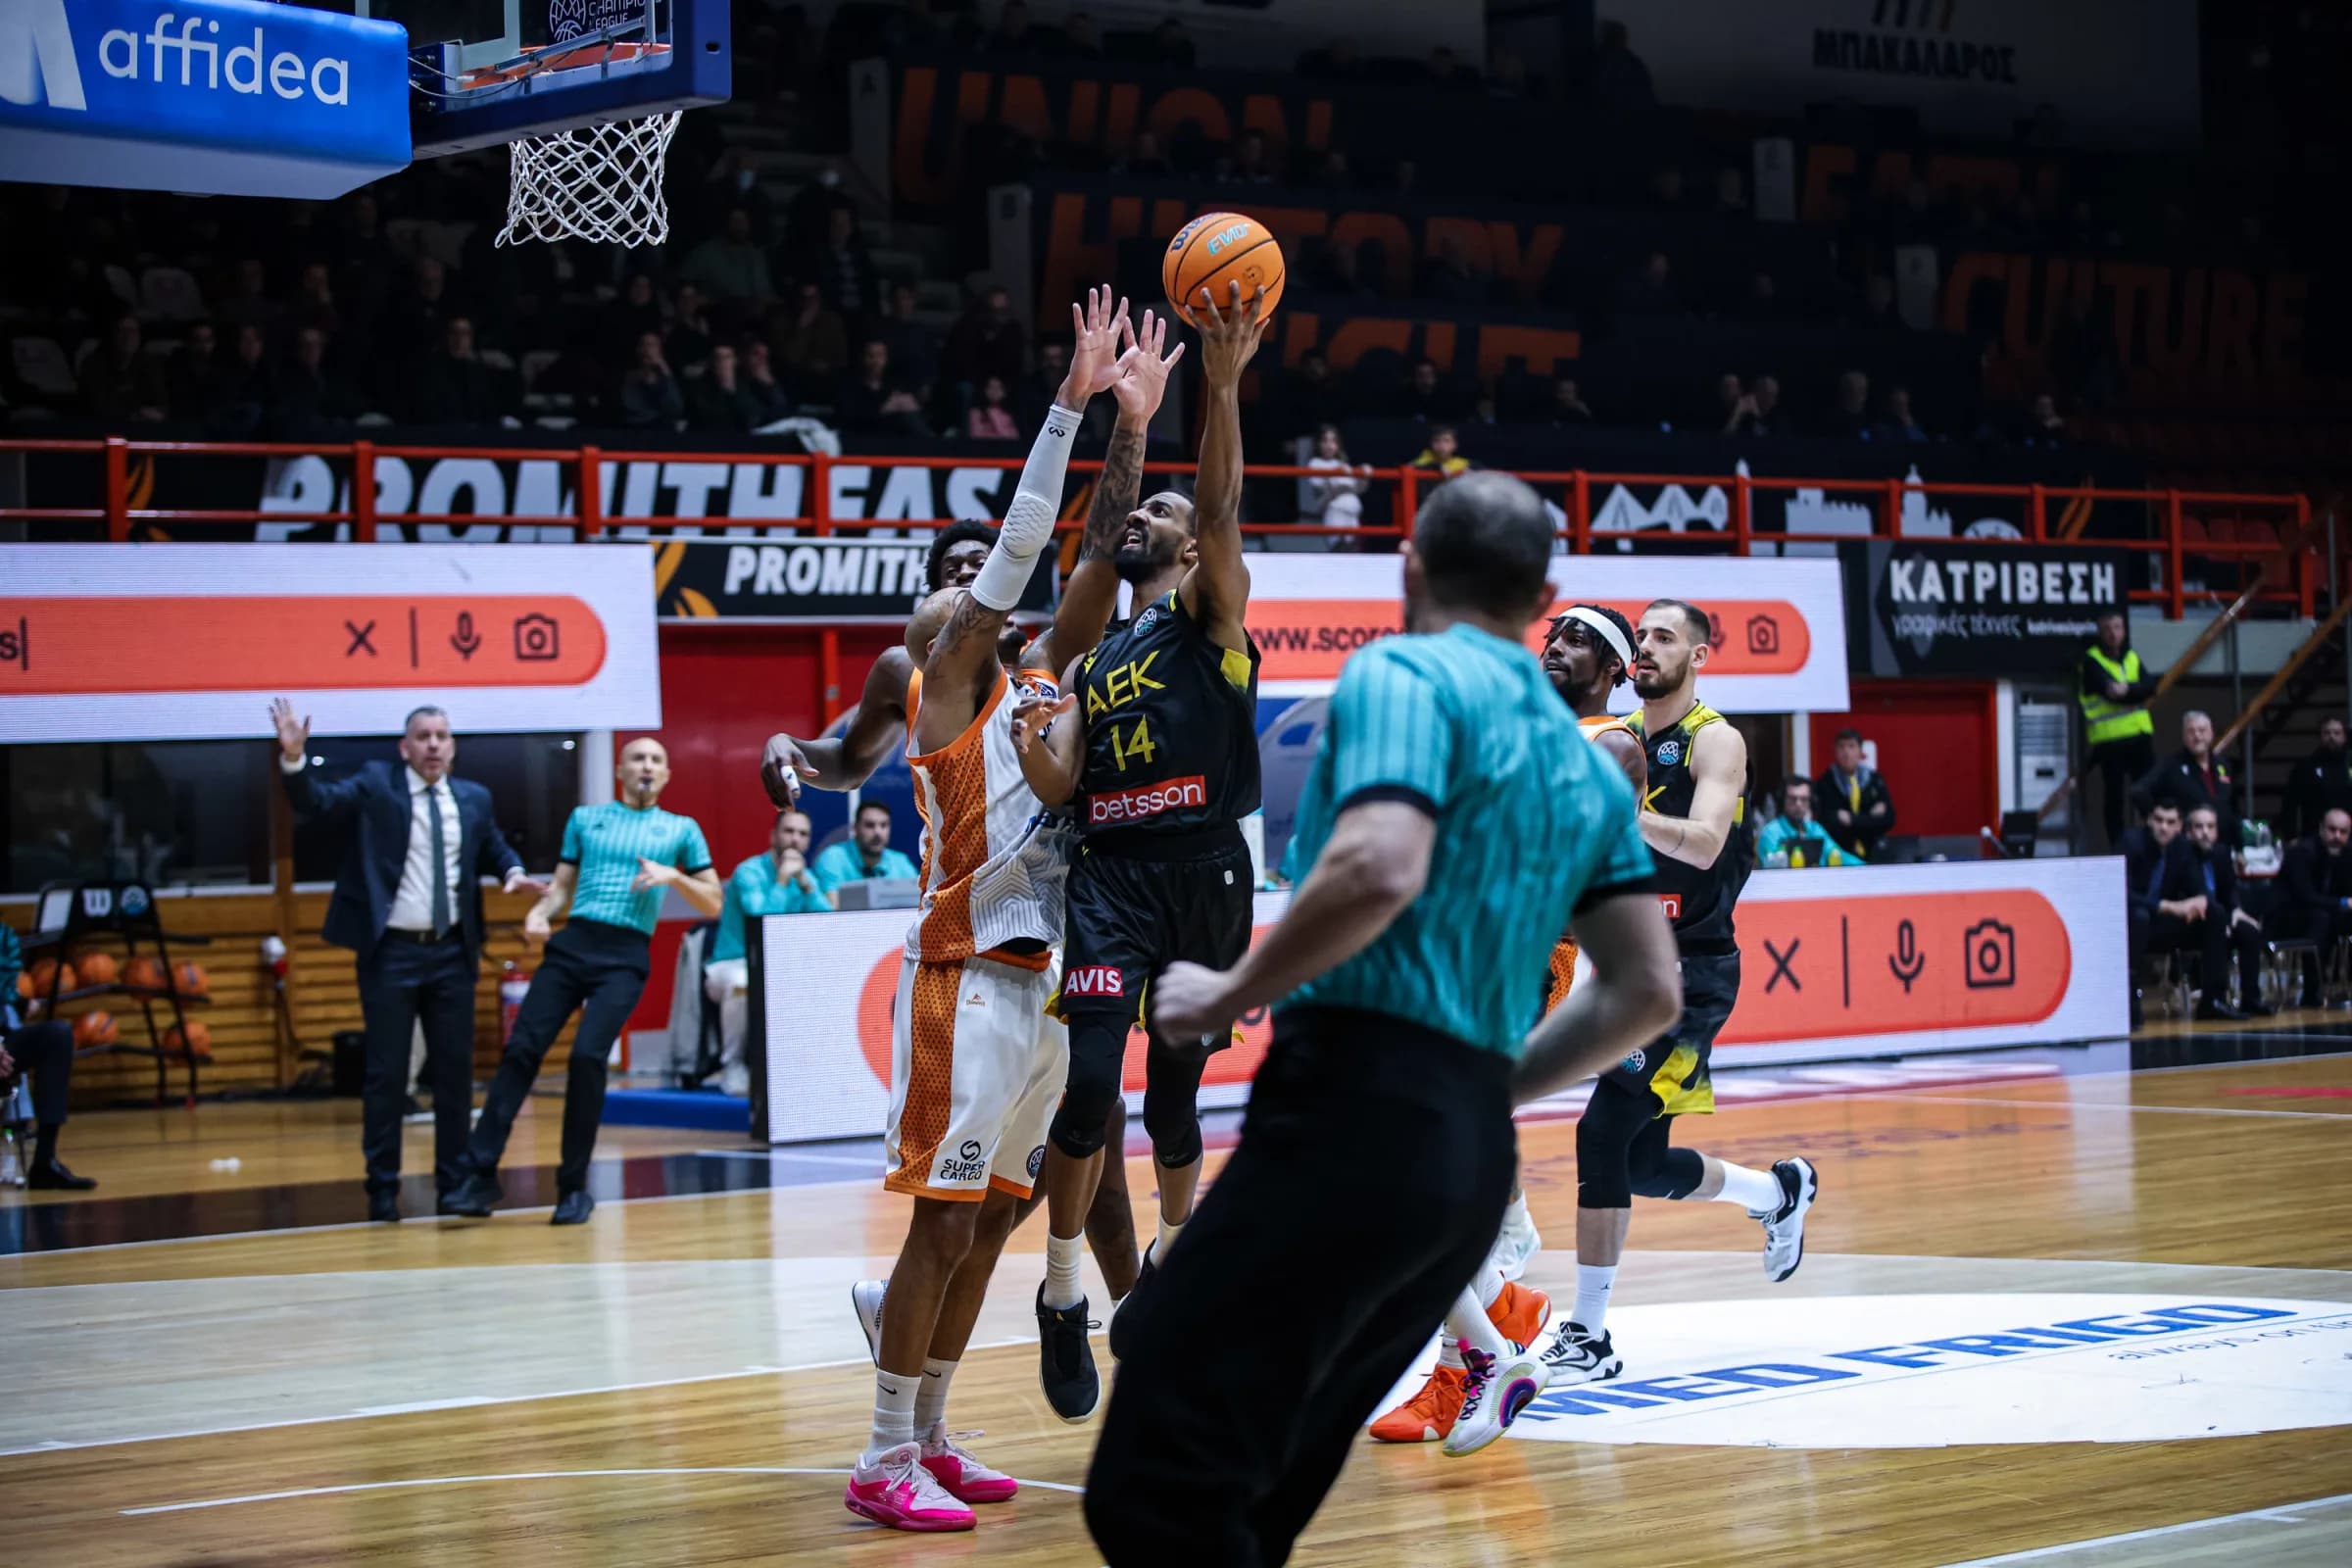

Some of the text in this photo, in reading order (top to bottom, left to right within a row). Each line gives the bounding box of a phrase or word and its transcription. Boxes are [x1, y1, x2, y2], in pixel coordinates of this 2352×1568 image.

[99, 13, 349, 106] affidea
[1888, 560, 2116, 605] ΚΑΤΡΙΒΕΣΗ
[1086, 650, 1167, 726] AEK
[1109, 712, 1156, 772] 14
[1092, 783, 1202, 821] betsson
[1064, 968, 1121, 995] AVIS
[940, 1169, 983, 1181] CARGO
[944, 1158, 986, 1173] SUPER
[1821, 1304, 2299, 1368] FRIGO
